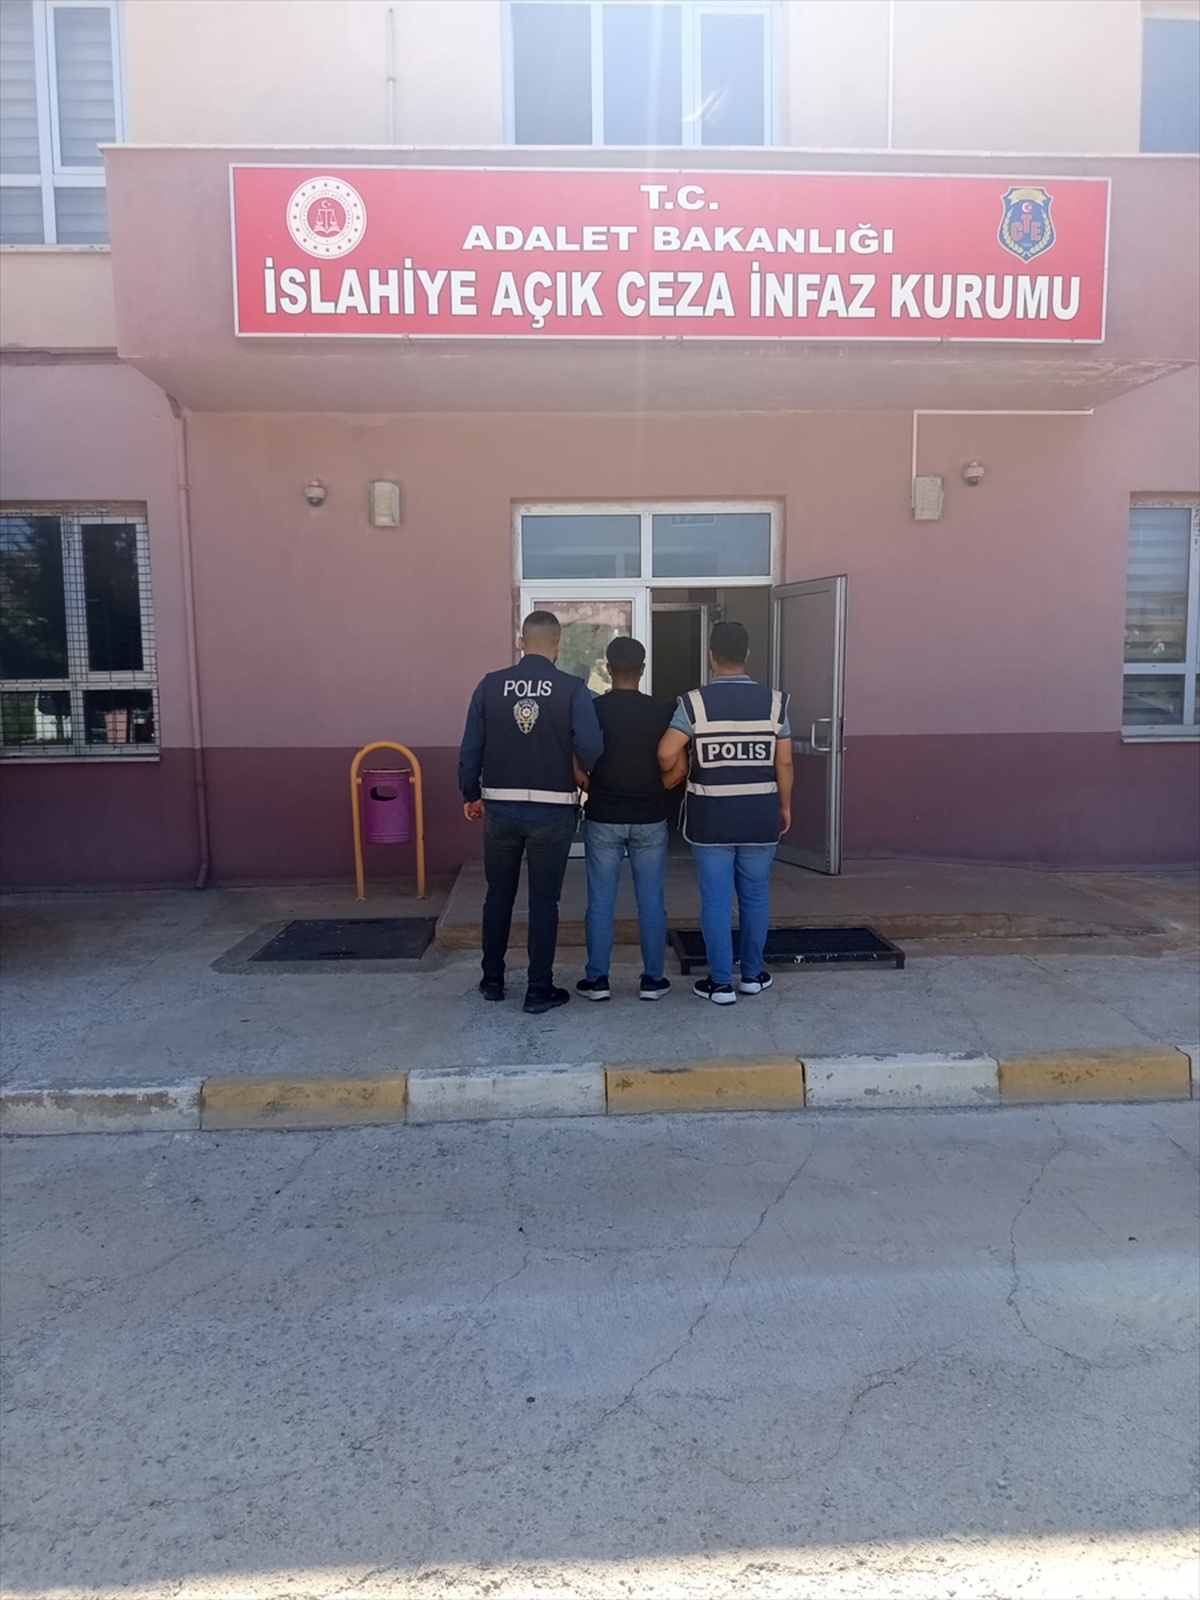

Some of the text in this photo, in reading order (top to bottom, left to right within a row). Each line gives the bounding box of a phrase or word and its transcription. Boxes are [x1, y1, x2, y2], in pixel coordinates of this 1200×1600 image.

[640, 184, 719, 211] T.C.
[462, 222, 894, 254] ADALET BAKANLIĞI
[264, 256, 1081, 329] İSLAHİYE AÇIK CEZA İNFAZ KURUMU
